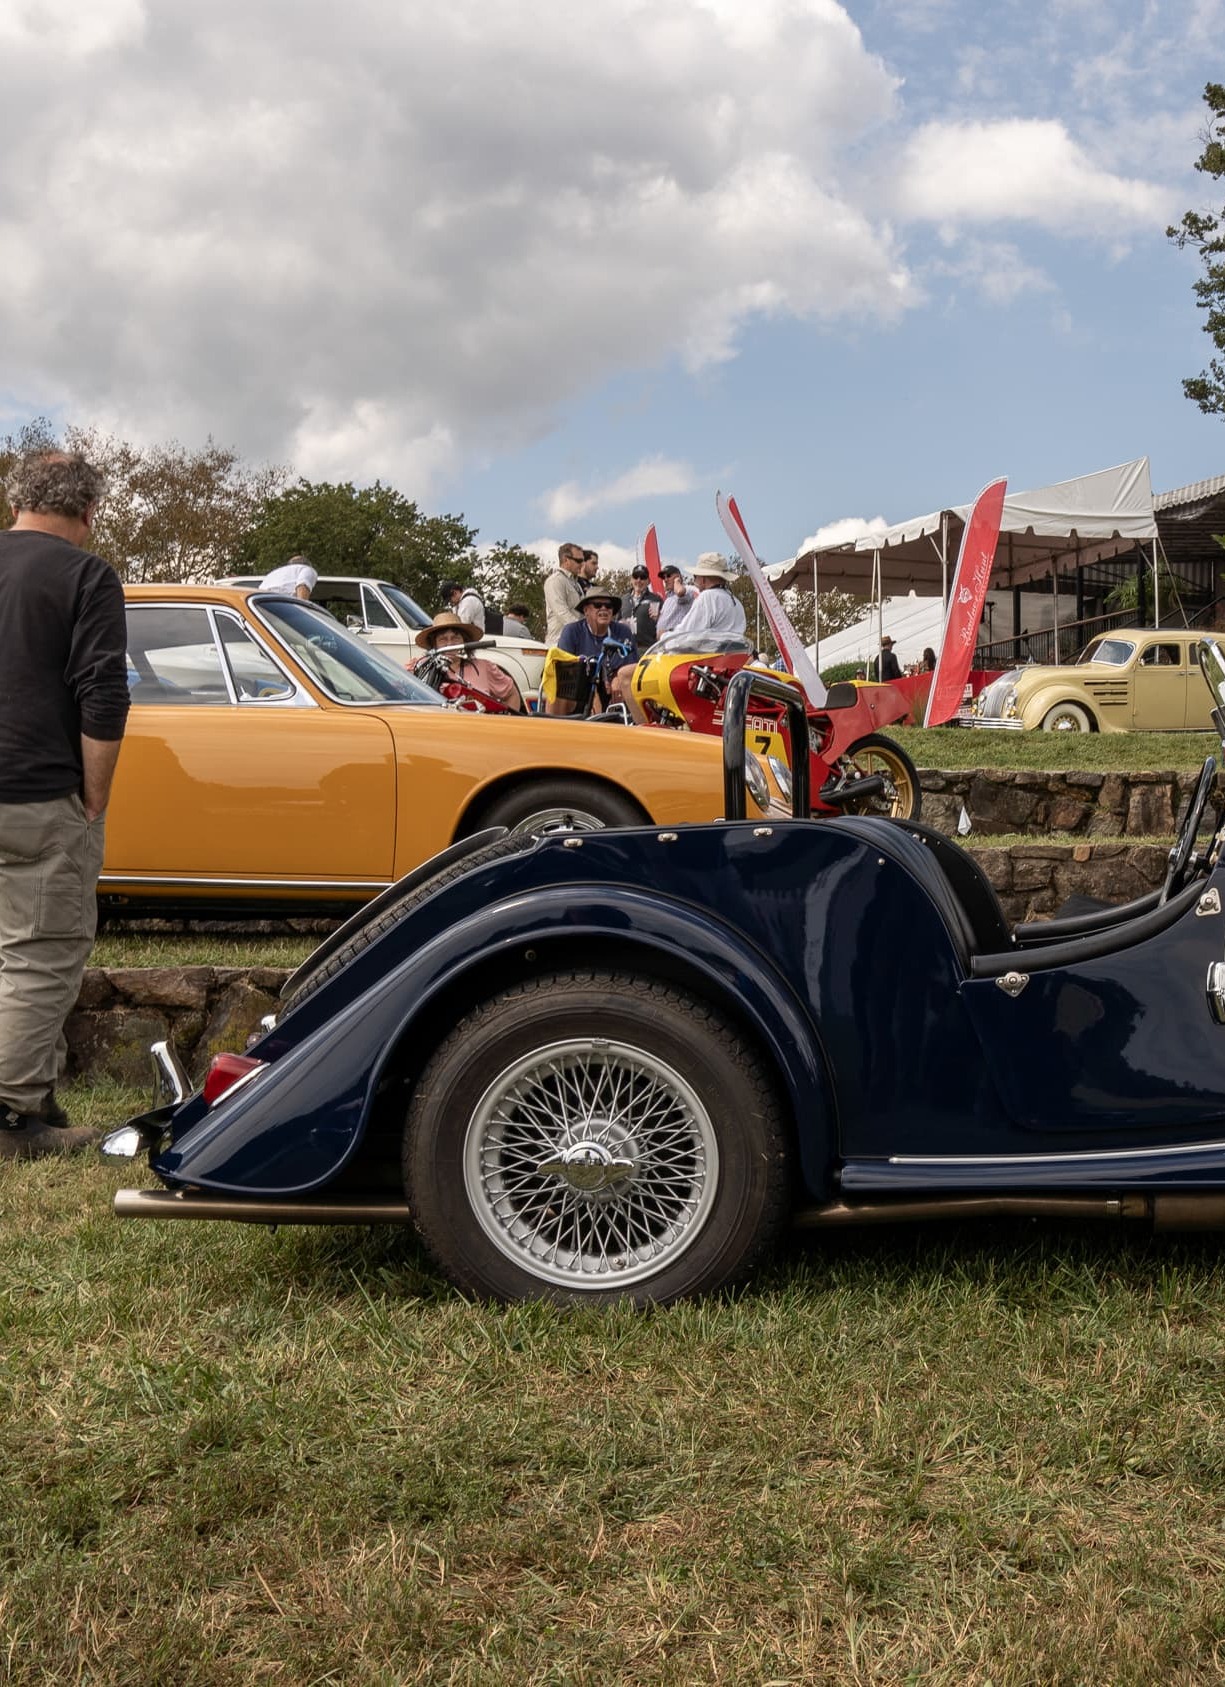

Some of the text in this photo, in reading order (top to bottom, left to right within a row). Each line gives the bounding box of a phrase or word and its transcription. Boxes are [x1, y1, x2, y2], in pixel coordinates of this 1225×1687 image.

[973, 551, 990, 593] Hunt
[637, 658, 653, 692] 7
[754, 735, 772, 755] 7
